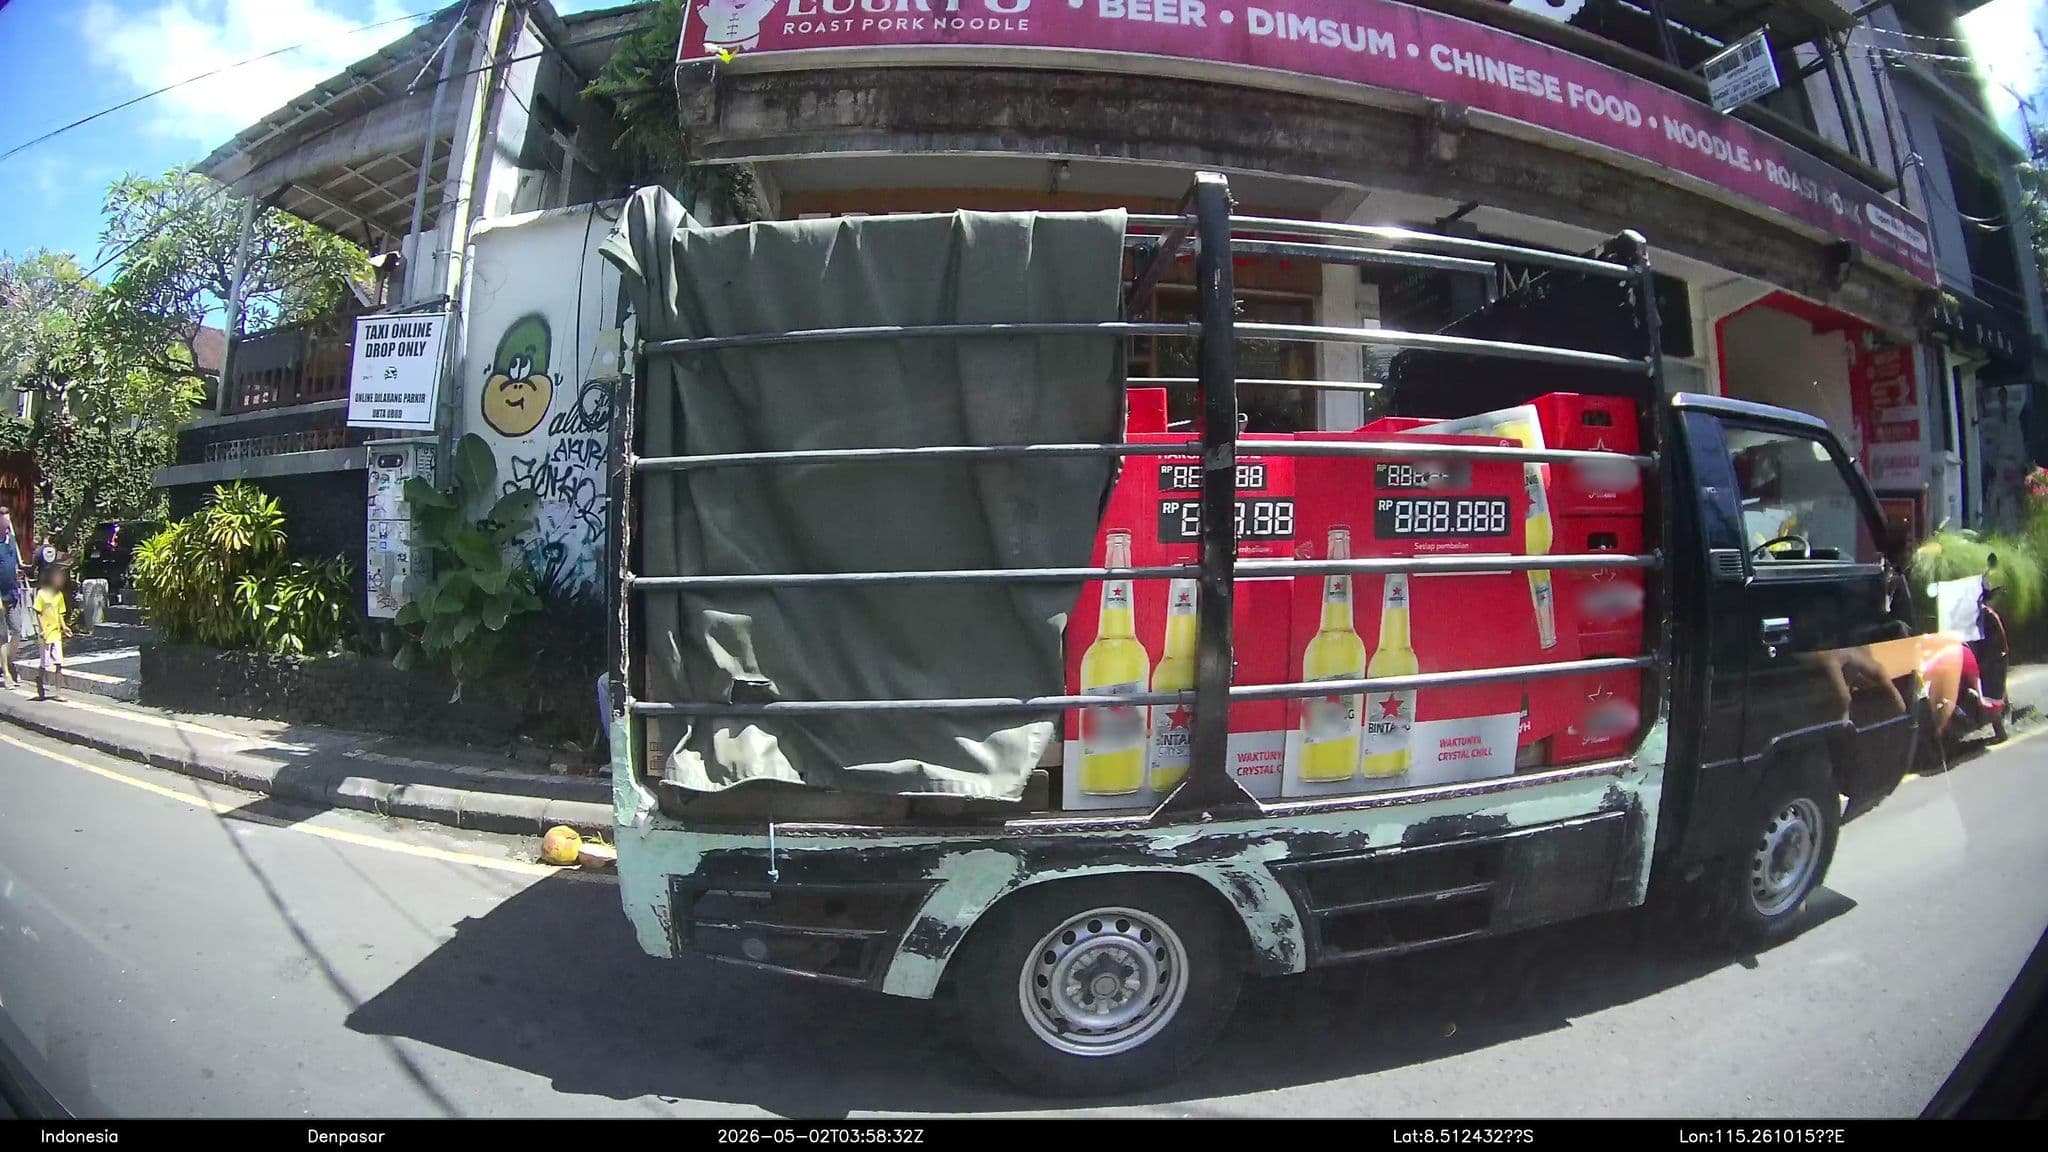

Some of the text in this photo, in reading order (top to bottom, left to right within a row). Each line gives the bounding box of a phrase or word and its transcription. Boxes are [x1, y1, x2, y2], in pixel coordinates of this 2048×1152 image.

[783, 17, 1029, 35] ROAST PORK NOODLE
[1099, 0, 1208, 28] BEER
[1248, 8, 1397, 59] DIMSUM
[1430, 43, 1563, 104] CHINESE
[1567, 81, 1643, 128] FOOD
[1663, 115, 1751, 172] NOODLE
[365, 322, 433, 340] TAXI ONLINE
[365, 341, 427, 358] DROP ONLY
[355, 393, 374, 403] ONLINE
[403, 393, 426, 404] PARKIR
[1161, 466, 1173, 474] RP
[1162, 502, 1180, 514] RP
[1378, 500, 1393, 511] RP
[1237, 751, 1282, 762] WAKTUNY
[1438, 750, 1470, 761] CRYSTAL
[1236, 765, 1273, 776] CRYSTAL
